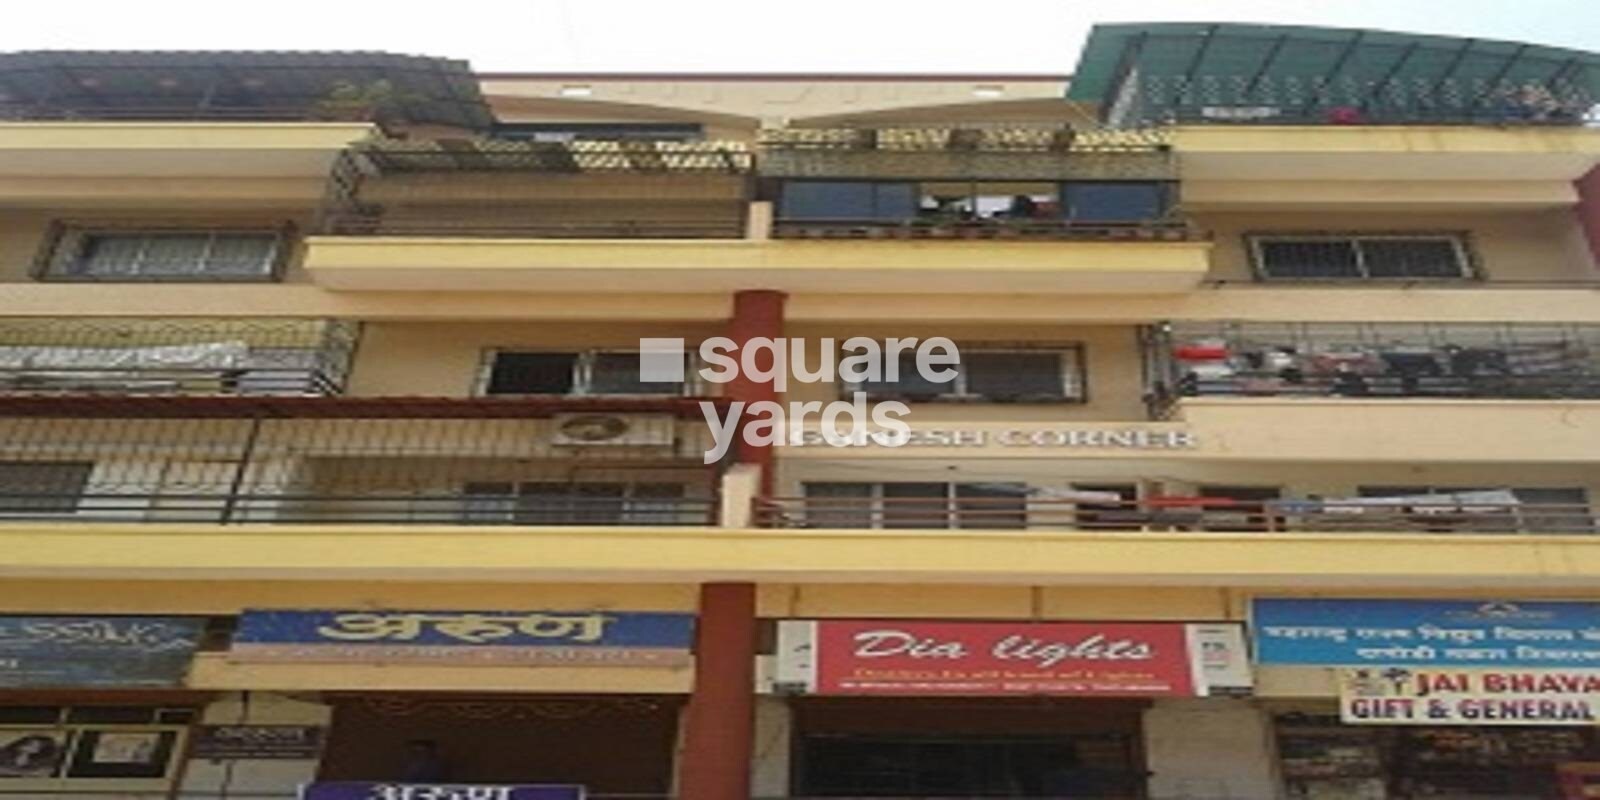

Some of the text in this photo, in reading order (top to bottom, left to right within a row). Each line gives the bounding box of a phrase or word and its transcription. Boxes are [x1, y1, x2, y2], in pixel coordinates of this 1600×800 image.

[999, 429, 1196, 449] CORNER
[318, 612, 615, 642] अरुण
[853, 629, 1154, 668] Dia lights
[1416, 673, 1469, 696] JAI
[1351, 698, 1596, 720] GIFT & GENERAL
